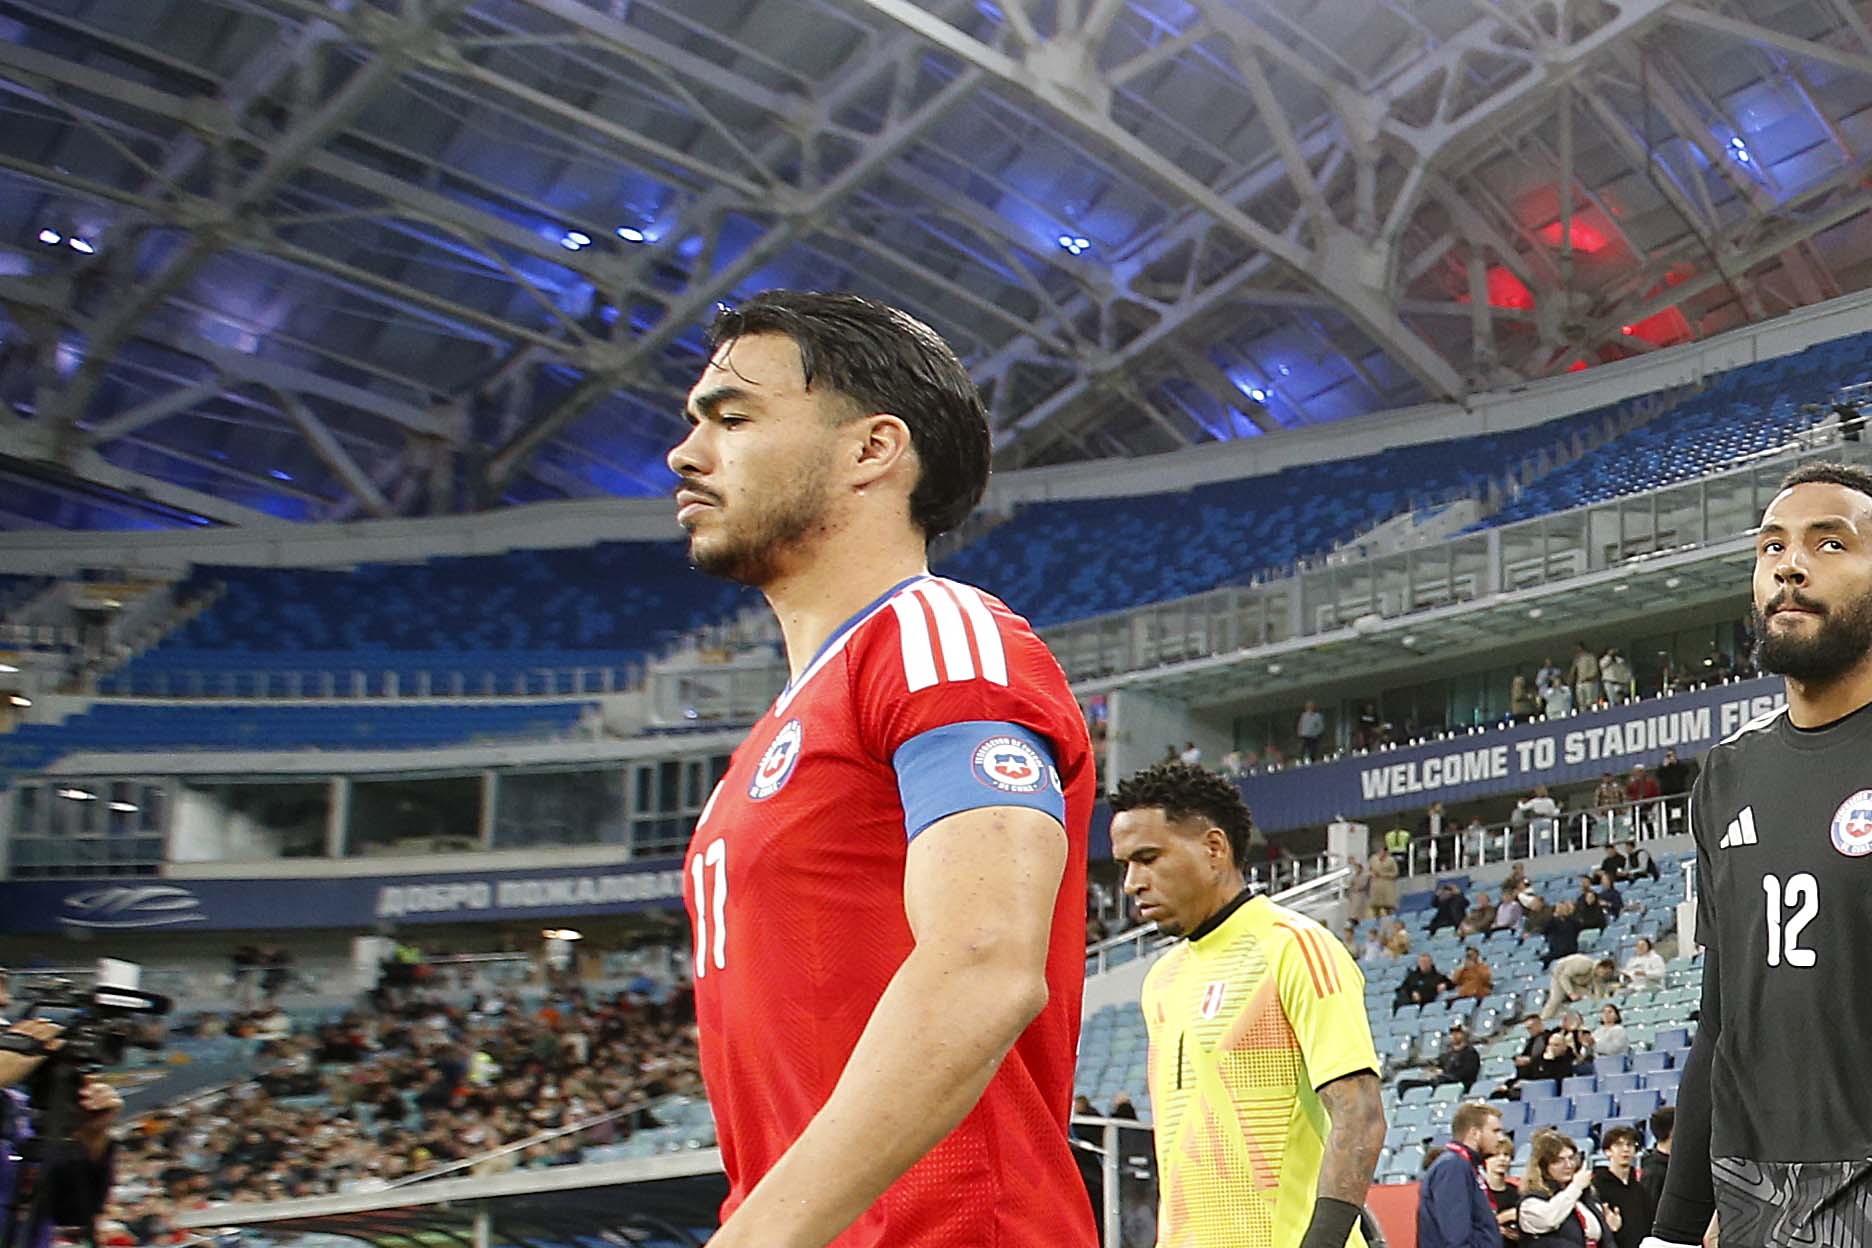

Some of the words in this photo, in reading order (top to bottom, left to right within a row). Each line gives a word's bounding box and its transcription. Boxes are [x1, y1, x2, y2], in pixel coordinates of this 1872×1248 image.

[1361, 744, 1509, 801] WELCOME
[1515, 736, 1556, 774] TO
[1564, 707, 1711, 766] STADIUM
[691, 837, 728, 978] 17
[1762, 873, 1819, 967] 12
